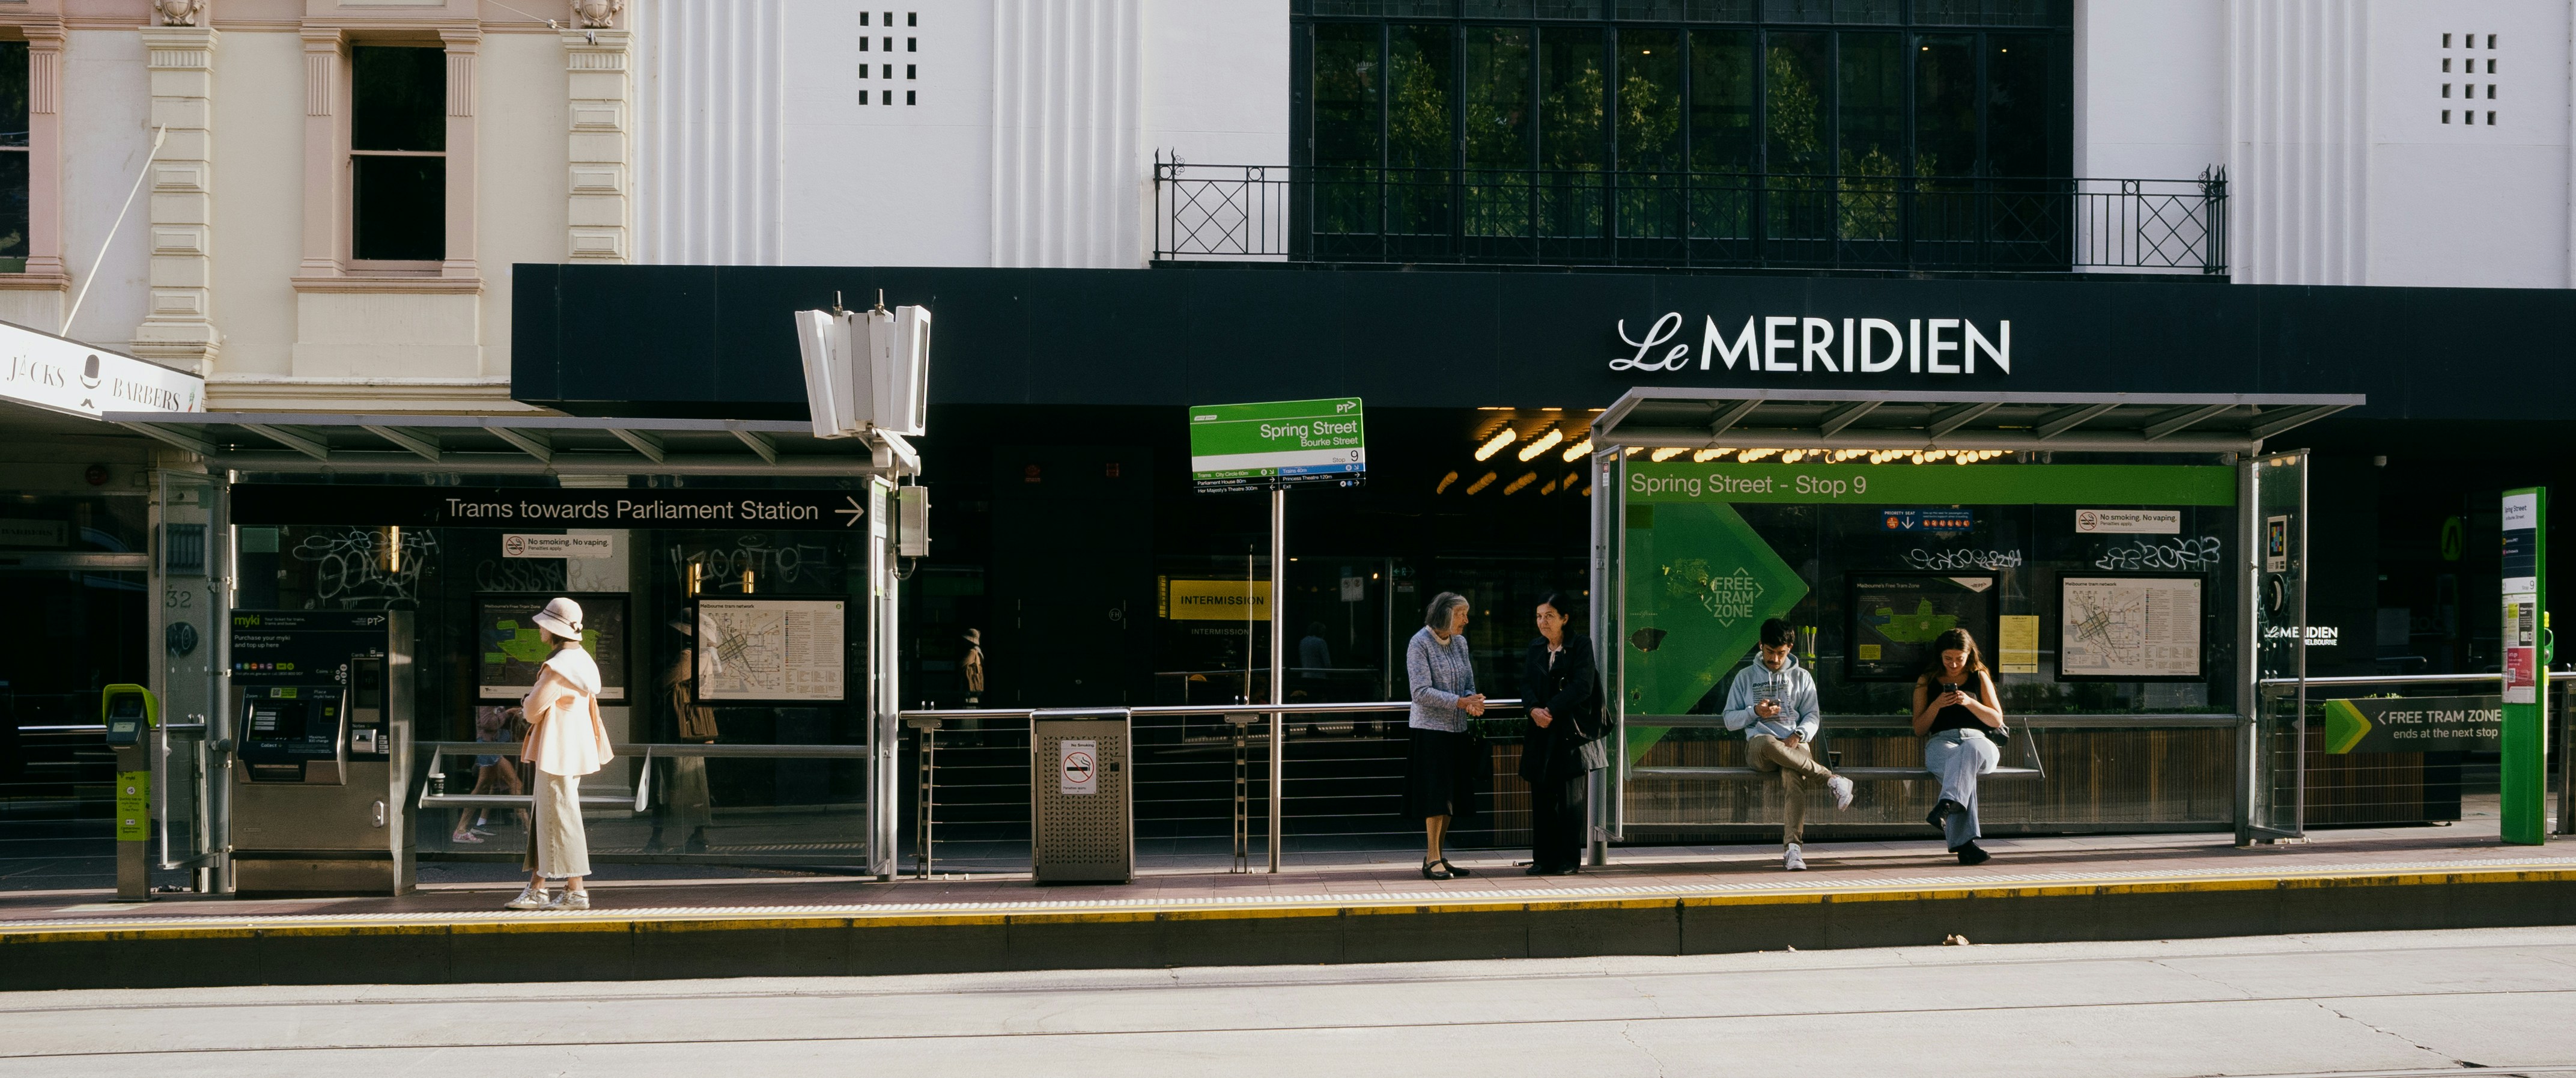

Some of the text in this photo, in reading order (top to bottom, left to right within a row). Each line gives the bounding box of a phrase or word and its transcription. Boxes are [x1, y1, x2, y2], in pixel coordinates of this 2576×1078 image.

[1609, 312, 2009, 374] Le MERIDIEN
[113, 379, 180, 411] BARBERS
[1260, 420, 1358, 440] Spring Street
[1301, 436, 1358, 448] Bourke Street
[1350, 450, 1359, 461] 9
[1631, 473, 1701, 497] Spring
[1709, 474, 1773, 494] Street
[1796, 475, 1847, 498] Stop
[1854, 477, 1867, 494] 9
[446, 498, 818, 520] Trams towards Parliament Station
[2110, 514, 2141, 522] smoking.
[539, 538, 571, 547] smoking.
[583, 539, 609, 547] vaping.
[1714, 577, 1754, 591] FREE
[2530, 580, 2535, 590] 9
[166, 590, 192, 609] 32
[1180, 595, 1264, 606] INTERMISSION
[1715, 591, 1754, 604] TRAM
[1714, 604, 1754, 618] ZONE
[234, 614, 260, 629] myki
[2264, 626, 2338, 638] Le MEIDIEN
[2389, 710, 2502, 724] FREE TRAM ZONE
[2393, 728, 2498, 740] ends at the next stop
